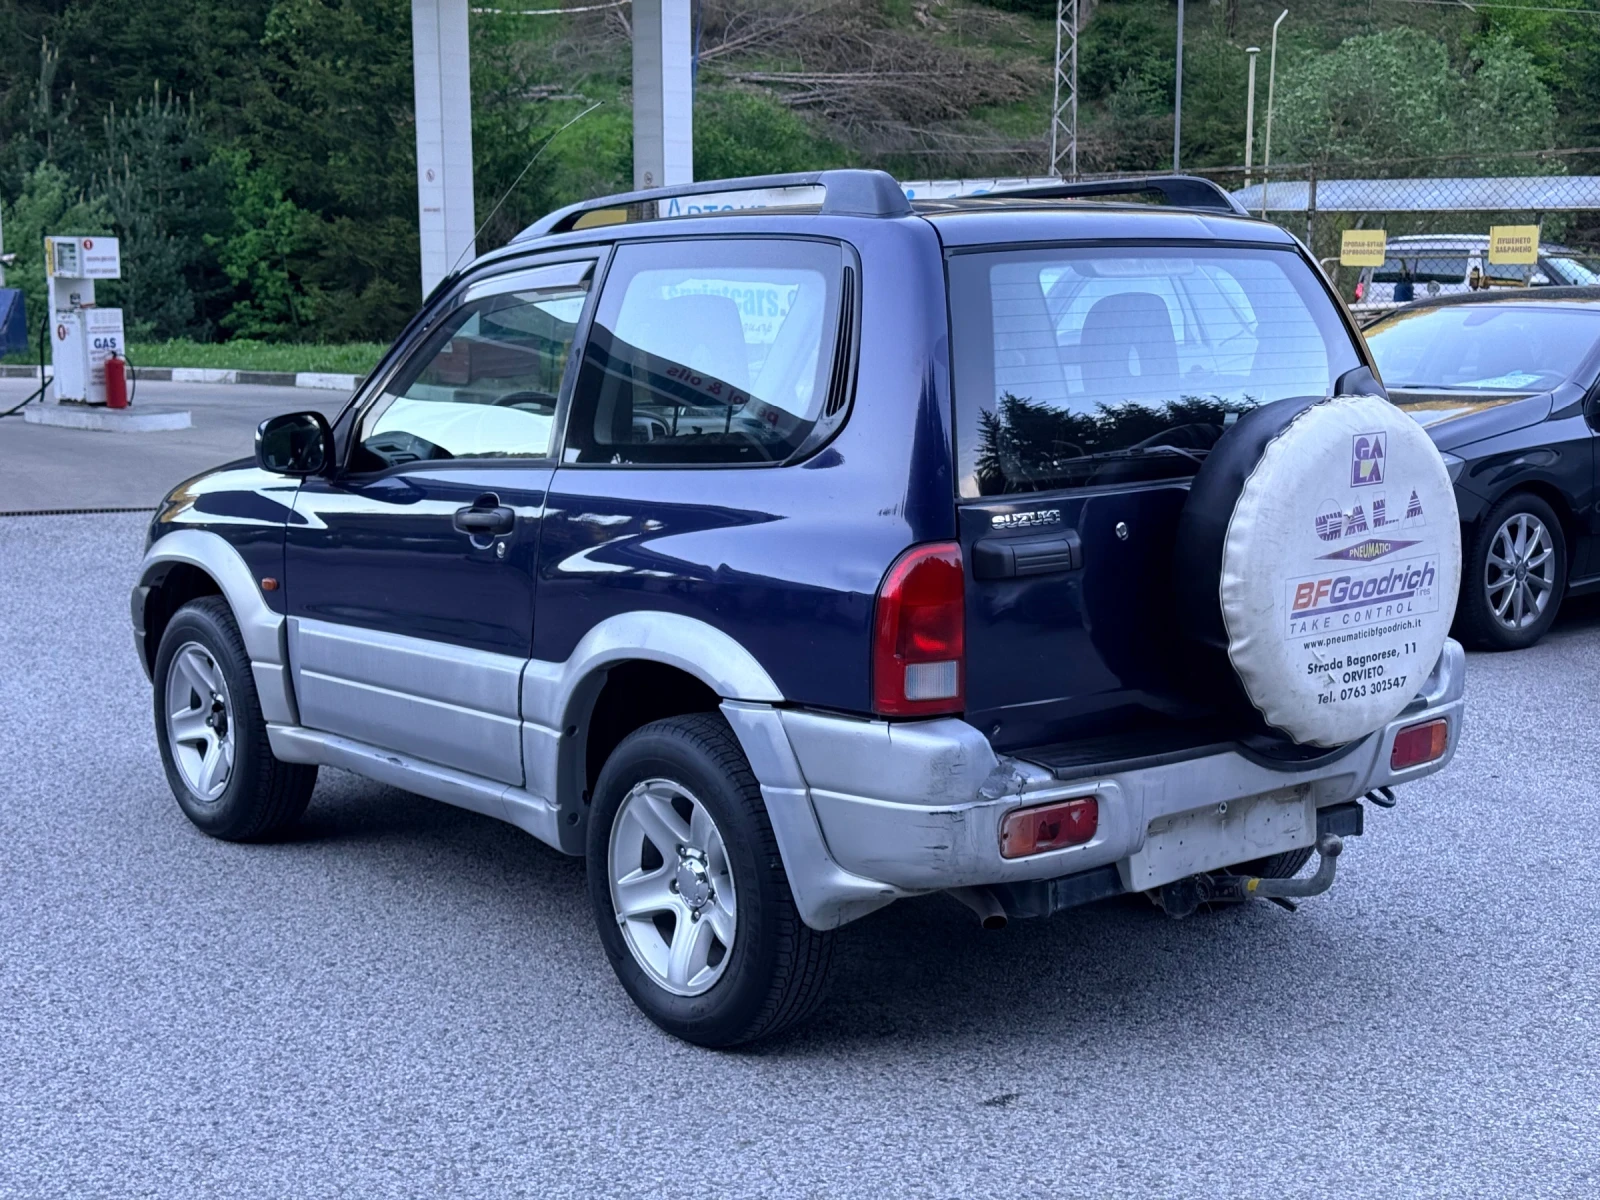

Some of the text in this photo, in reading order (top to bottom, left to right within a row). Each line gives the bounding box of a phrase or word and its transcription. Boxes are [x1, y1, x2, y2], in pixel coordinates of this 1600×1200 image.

[1495, 245, 1532, 254] ЗАБРАНЕНО
[1497, 237, 1532, 245] ПУШЕНЕТО
[94, 337, 117, 349] GAS
[991, 509, 1061, 530] SUZUKI
[1315, 486, 1427, 541] GALA
[1349, 543, 1391, 558] PNEUMATICI
[1292, 561, 1436, 611] BFGoodrich
[1290, 601, 1414, 635] TAKE CONTROL
[1303, 619, 1422, 650] www.pneumaticibfgoodrich.it
[1307, 642, 1417, 675] Strada Bagnorese, 11
[1342, 665, 1384, 684] ORVIETO
[1317, 676, 1407, 705] Tel. 0763 302547
